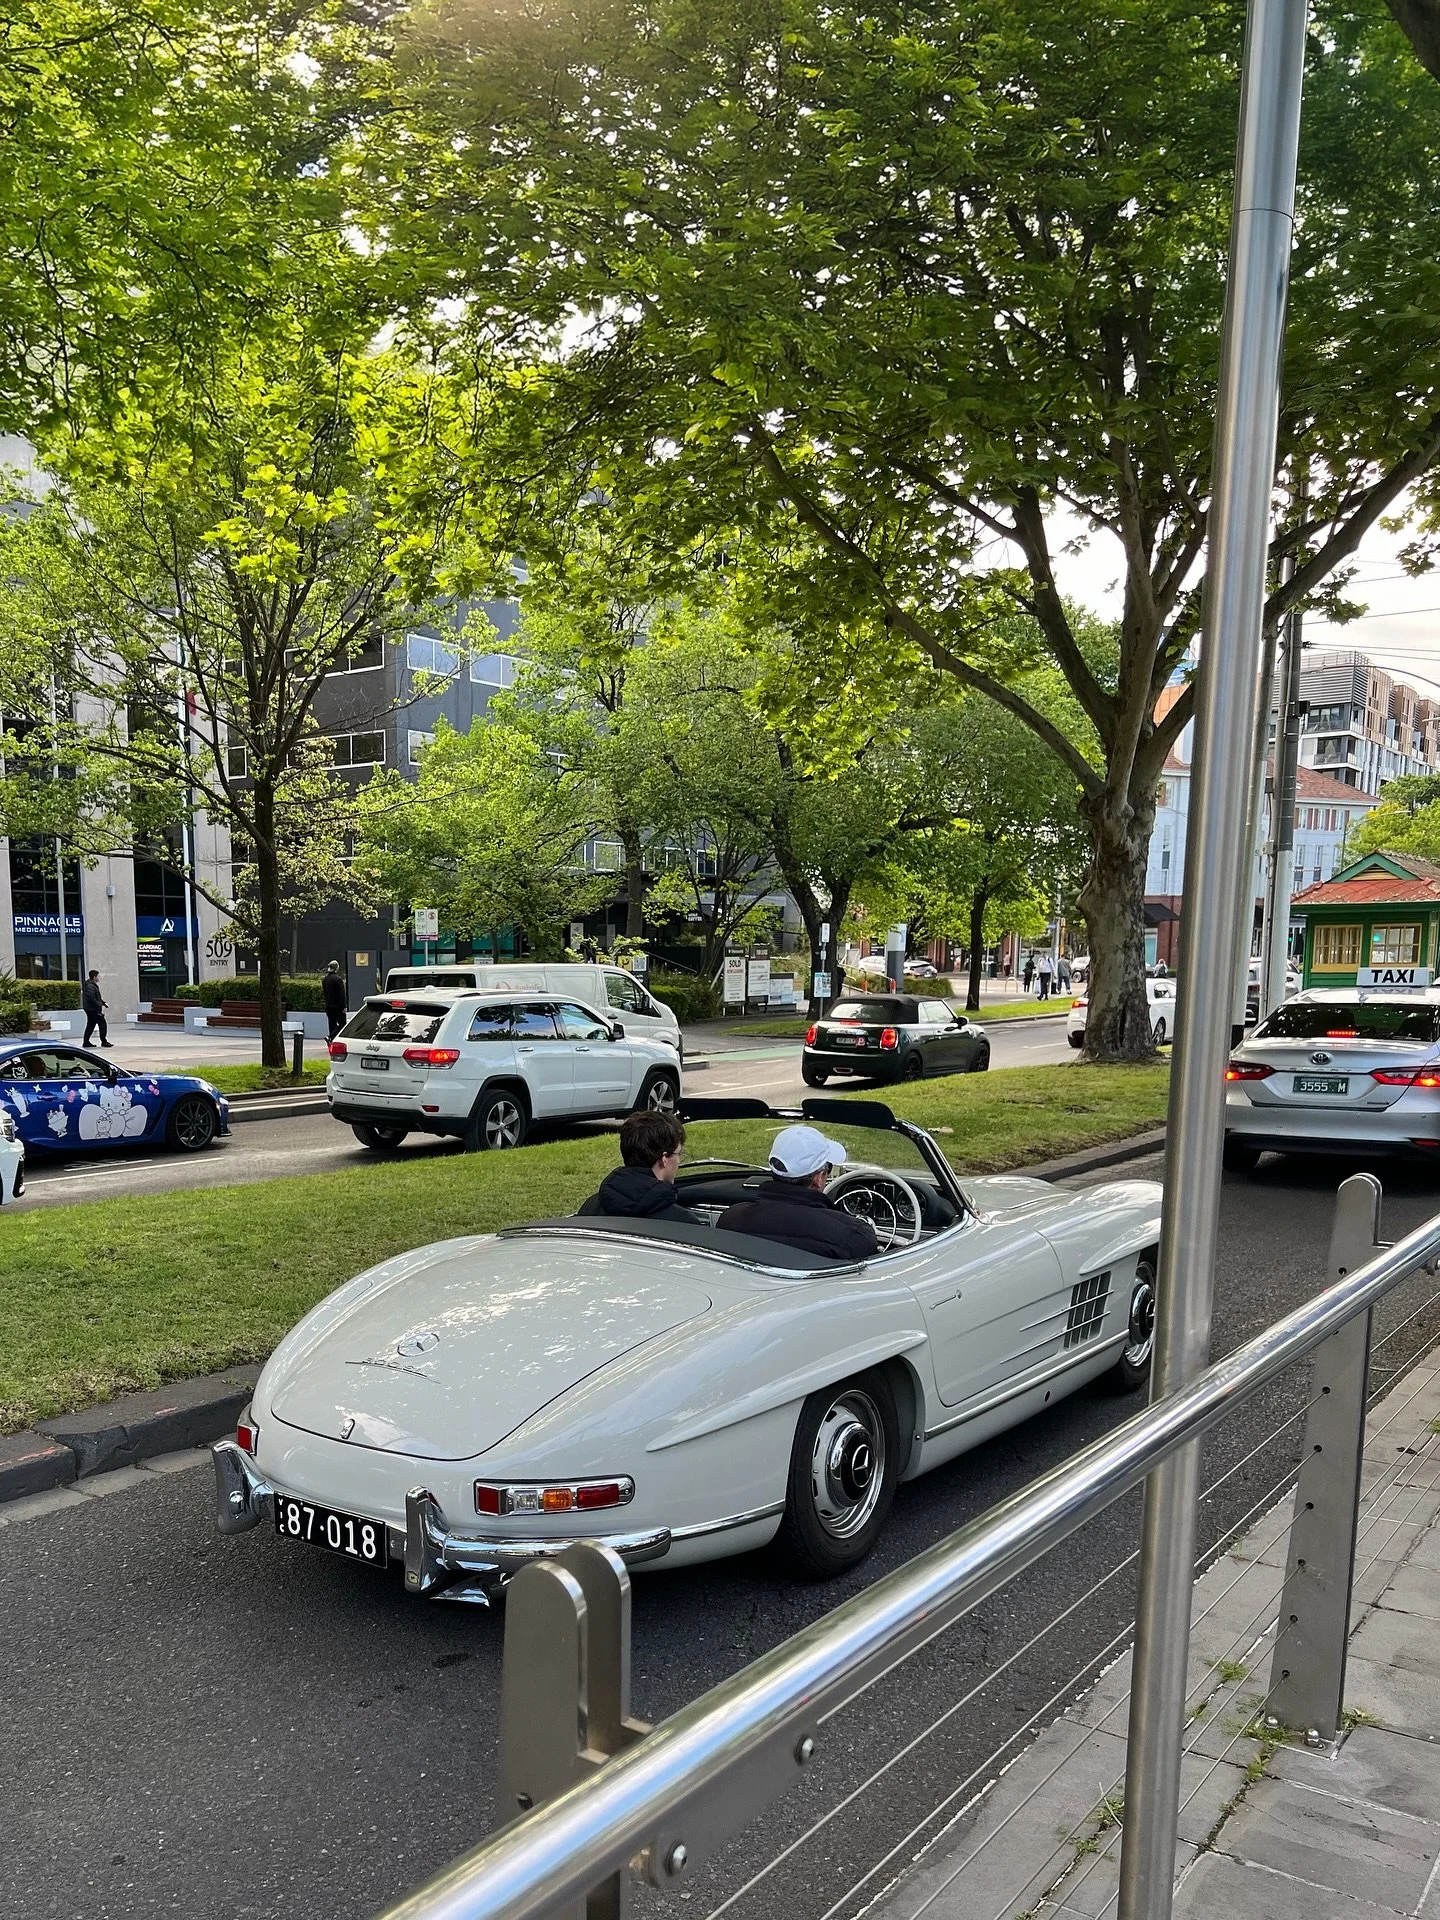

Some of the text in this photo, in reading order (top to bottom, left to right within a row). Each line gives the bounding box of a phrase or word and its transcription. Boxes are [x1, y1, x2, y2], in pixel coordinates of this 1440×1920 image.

[206, 940, 232, 958] 509
[1371, 970, 1414, 983] TAXI
[1300, 1082, 1328, 1092] 3555
[1338, 1083, 1346, 1092] M
